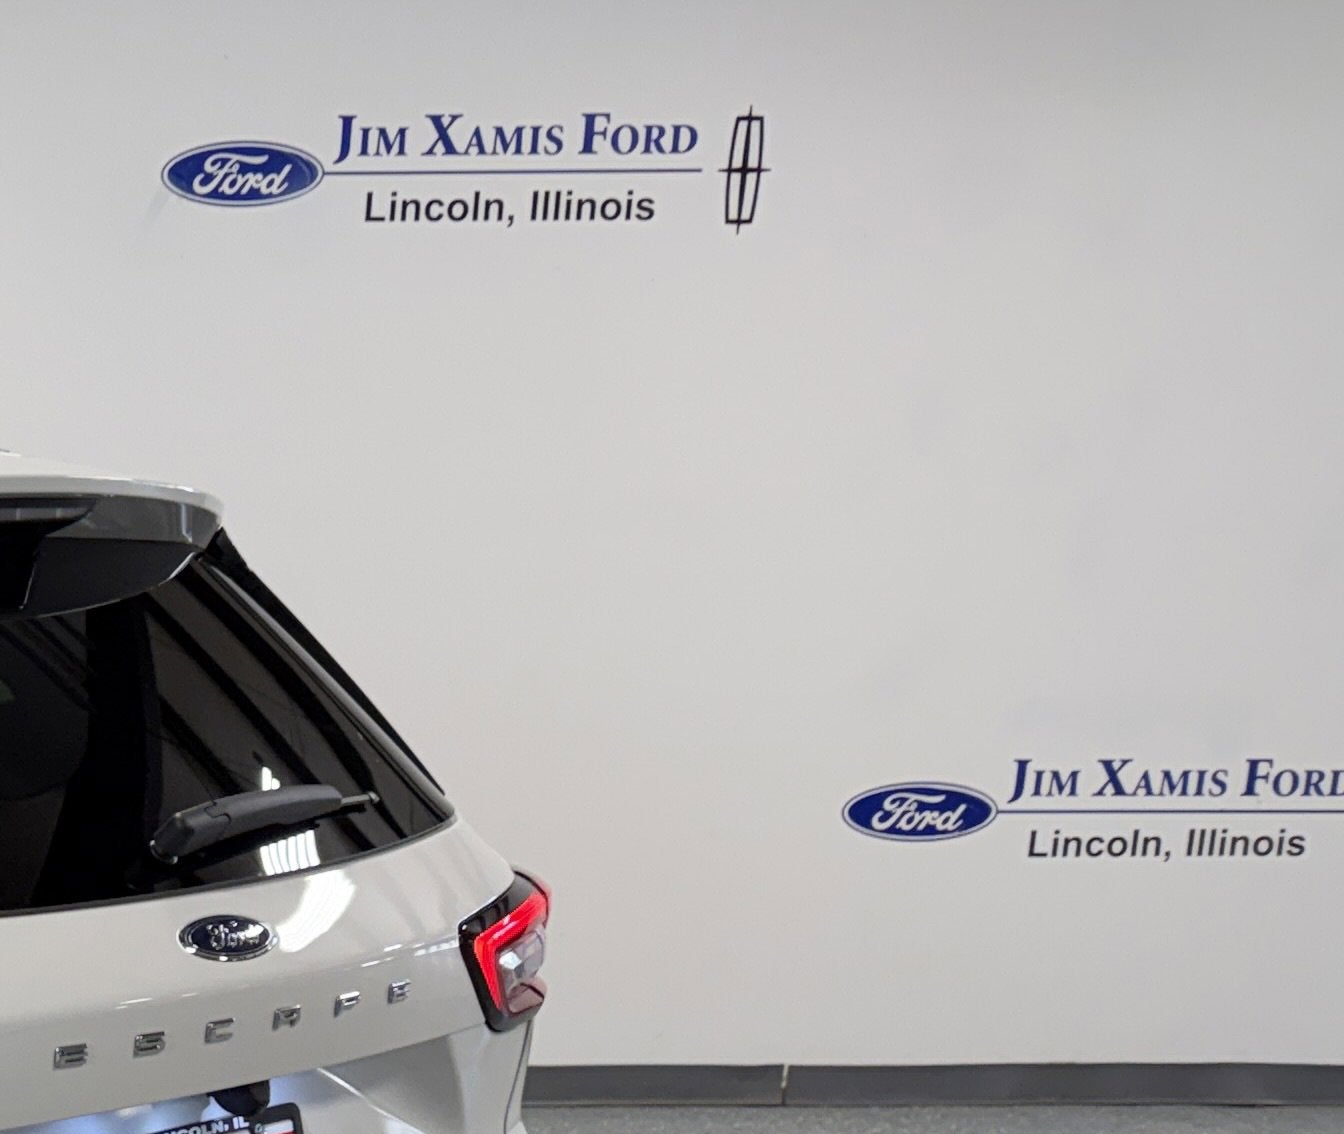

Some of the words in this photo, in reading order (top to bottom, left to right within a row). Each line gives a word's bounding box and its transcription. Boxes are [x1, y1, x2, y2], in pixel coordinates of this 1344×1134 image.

[334, 115, 408, 165] JIM
[421, 114, 564, 156] XAMIS
[578, 112, 699, 155] FORD
[192, 153, 291, 196] Ford
[364, 190, 515, 227] Lincoln,
[529, 190, 656, 222] Illinois
[1008, 759, 1080, 803] JIM
[1091, 759, 1228, 798] XAMIS
[870, 791, 967, 833] Ford
[1028, 828, 1172, 862] Lincoln,
[1185, 828, 1306, 857] Illinois
[53, 978, 412, 1069] ESCAPE
[232, 1116, 250, 1129] IL
